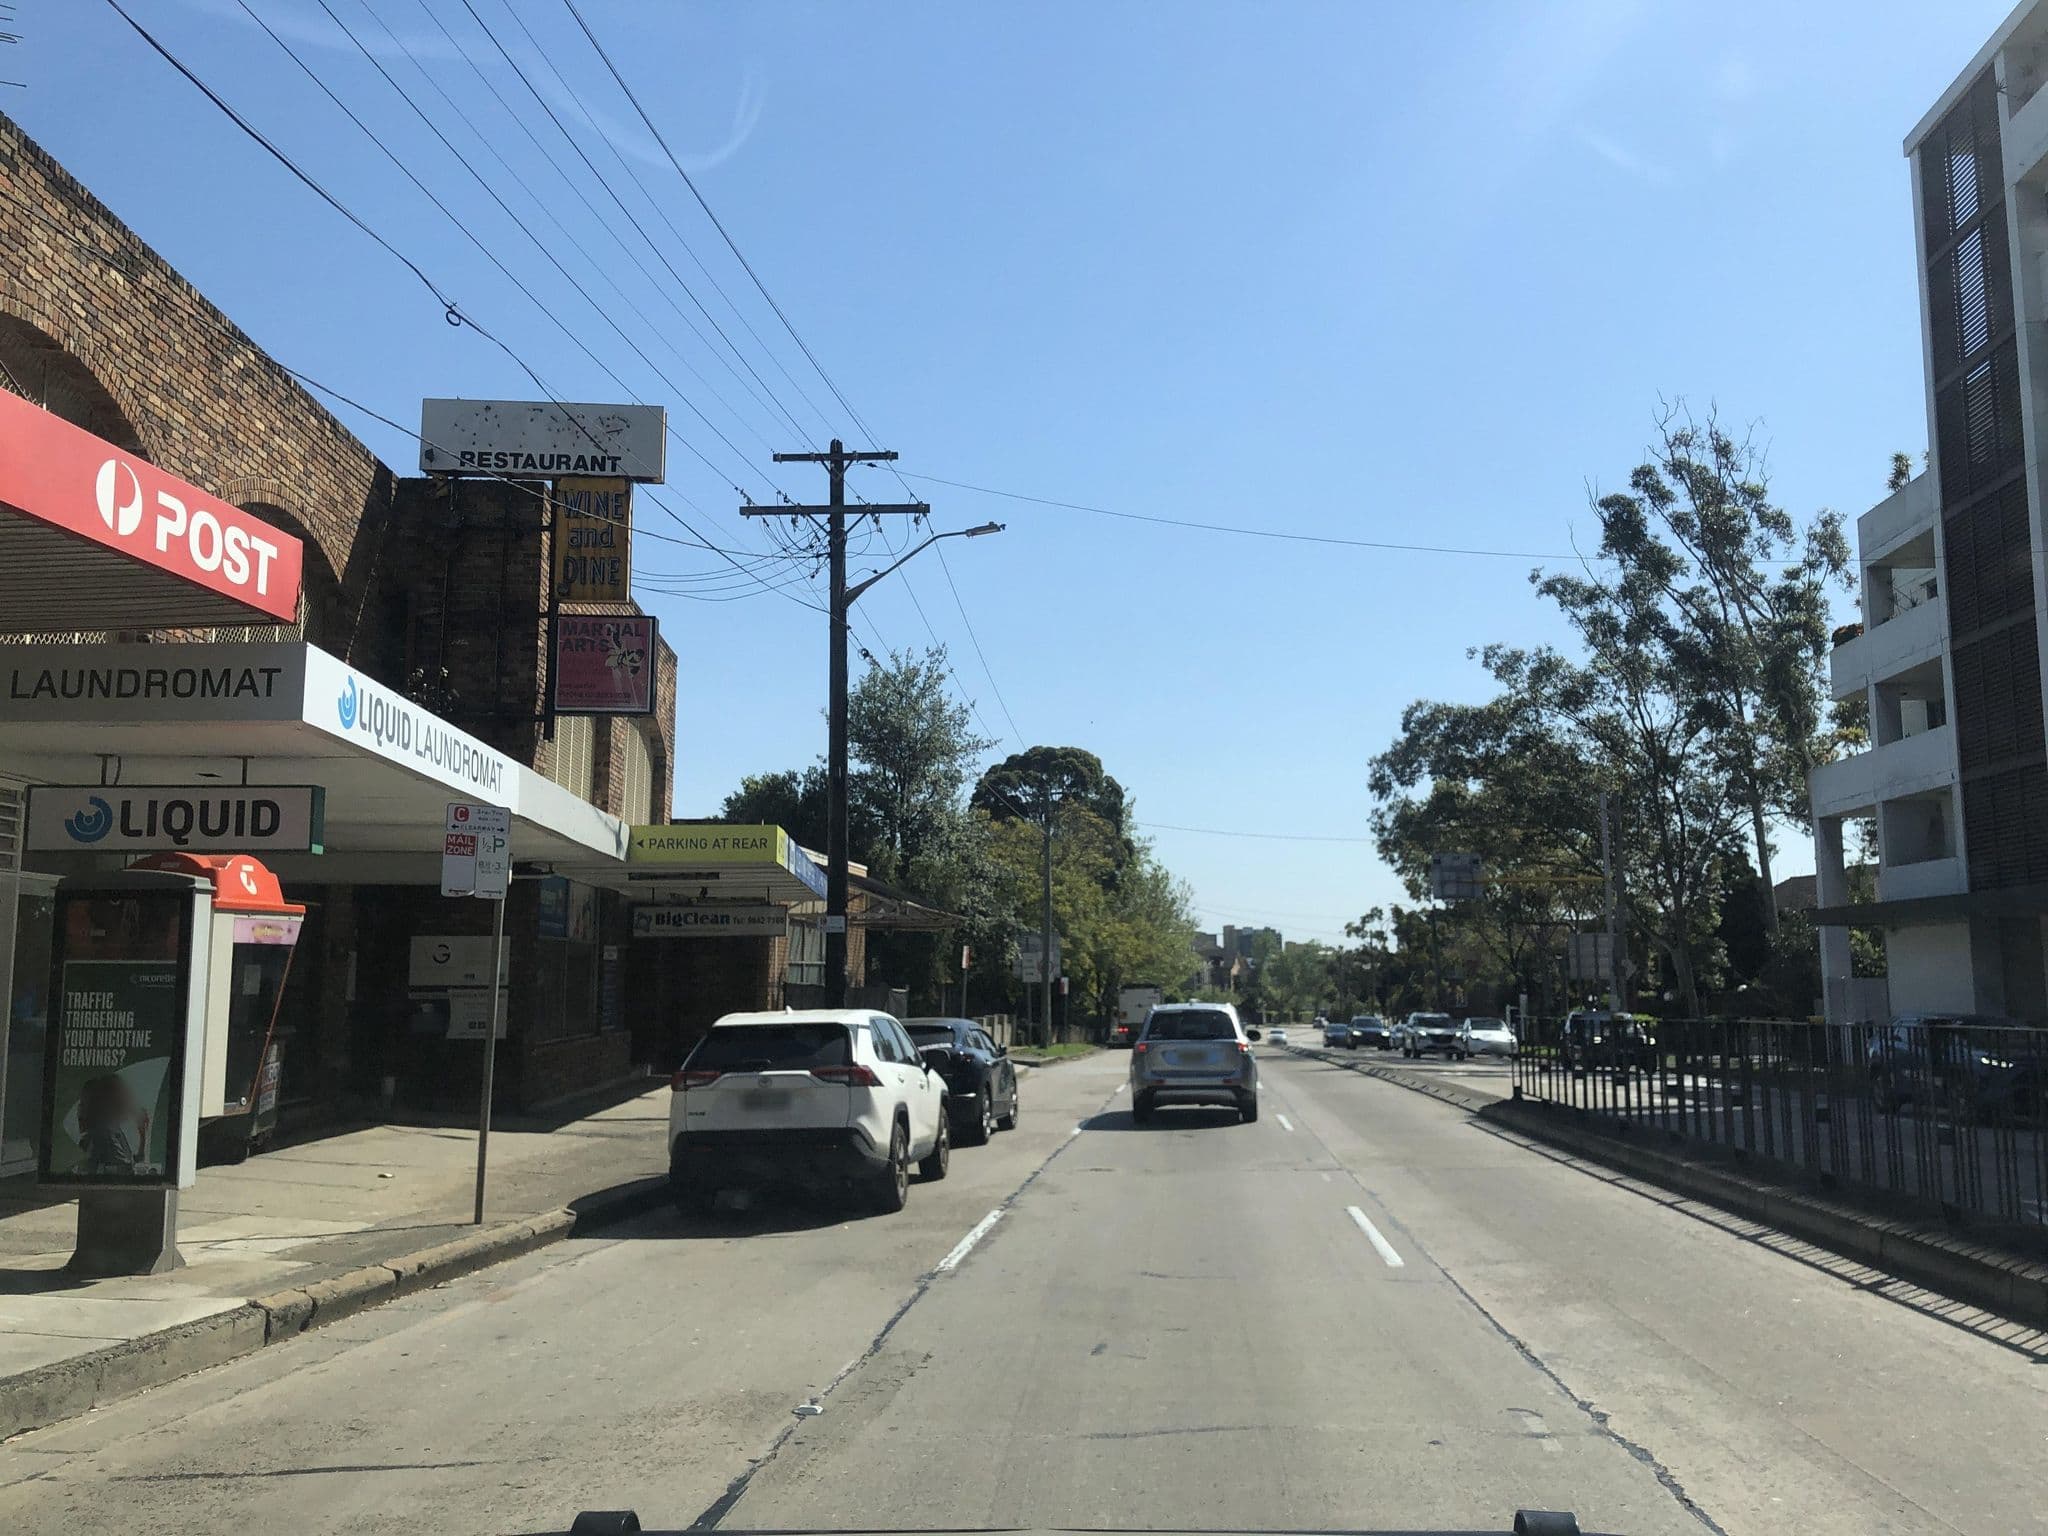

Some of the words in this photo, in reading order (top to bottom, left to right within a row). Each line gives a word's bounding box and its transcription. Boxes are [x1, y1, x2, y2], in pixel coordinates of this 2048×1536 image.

[460, 451, 622, 472] RESTAURANT
[563, 490, 625, 520] WINE
[156, 491, 278, 596] POST
[567, 525, 616, 548] and
[563, 555, 621, 586] DINE
[562, 639, 610, 652] ARTS
[10, 667, 282, 701] LAUNDROMAT
[359, 688, 411, 750] LIQUID
[415, 718, 503, 794] LAUNDROMAT
[119, 799, 281, 846] LIQUID
[447, 834, 474, 846] MAIL
[649, 838, 707, 850] PARKING
[712, 838, 729, 849] AT
[732, 837, 768, 849] REAR
[446, 845, 473, 856] ZONE
[67, 991, 114, 1010] TRAFFIC
[66, 1010, 135, 1029] TRIGGERING
[64, 1030, 94, 1048] YOUR
[97, 1030, 152, 1048] NICOTINE
[63, 1048, 126, 1067] CRAVINGS?
